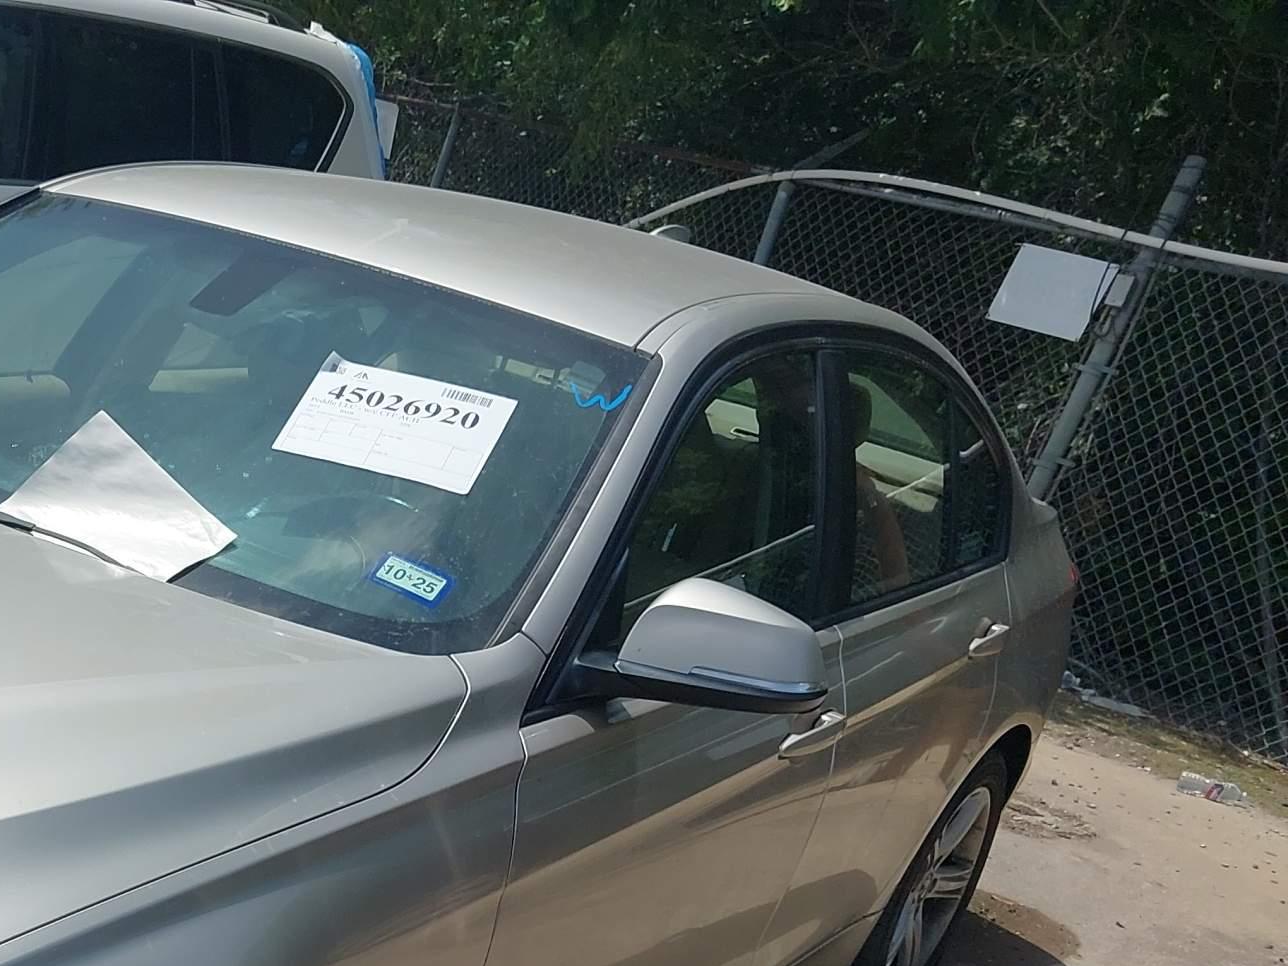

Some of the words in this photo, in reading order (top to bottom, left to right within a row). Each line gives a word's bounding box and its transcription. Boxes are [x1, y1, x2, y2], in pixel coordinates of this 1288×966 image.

[327, 384, 481, 430] 45026920
[384, 564, 407, 580] 10
[412, 577, 438, 594] 25
